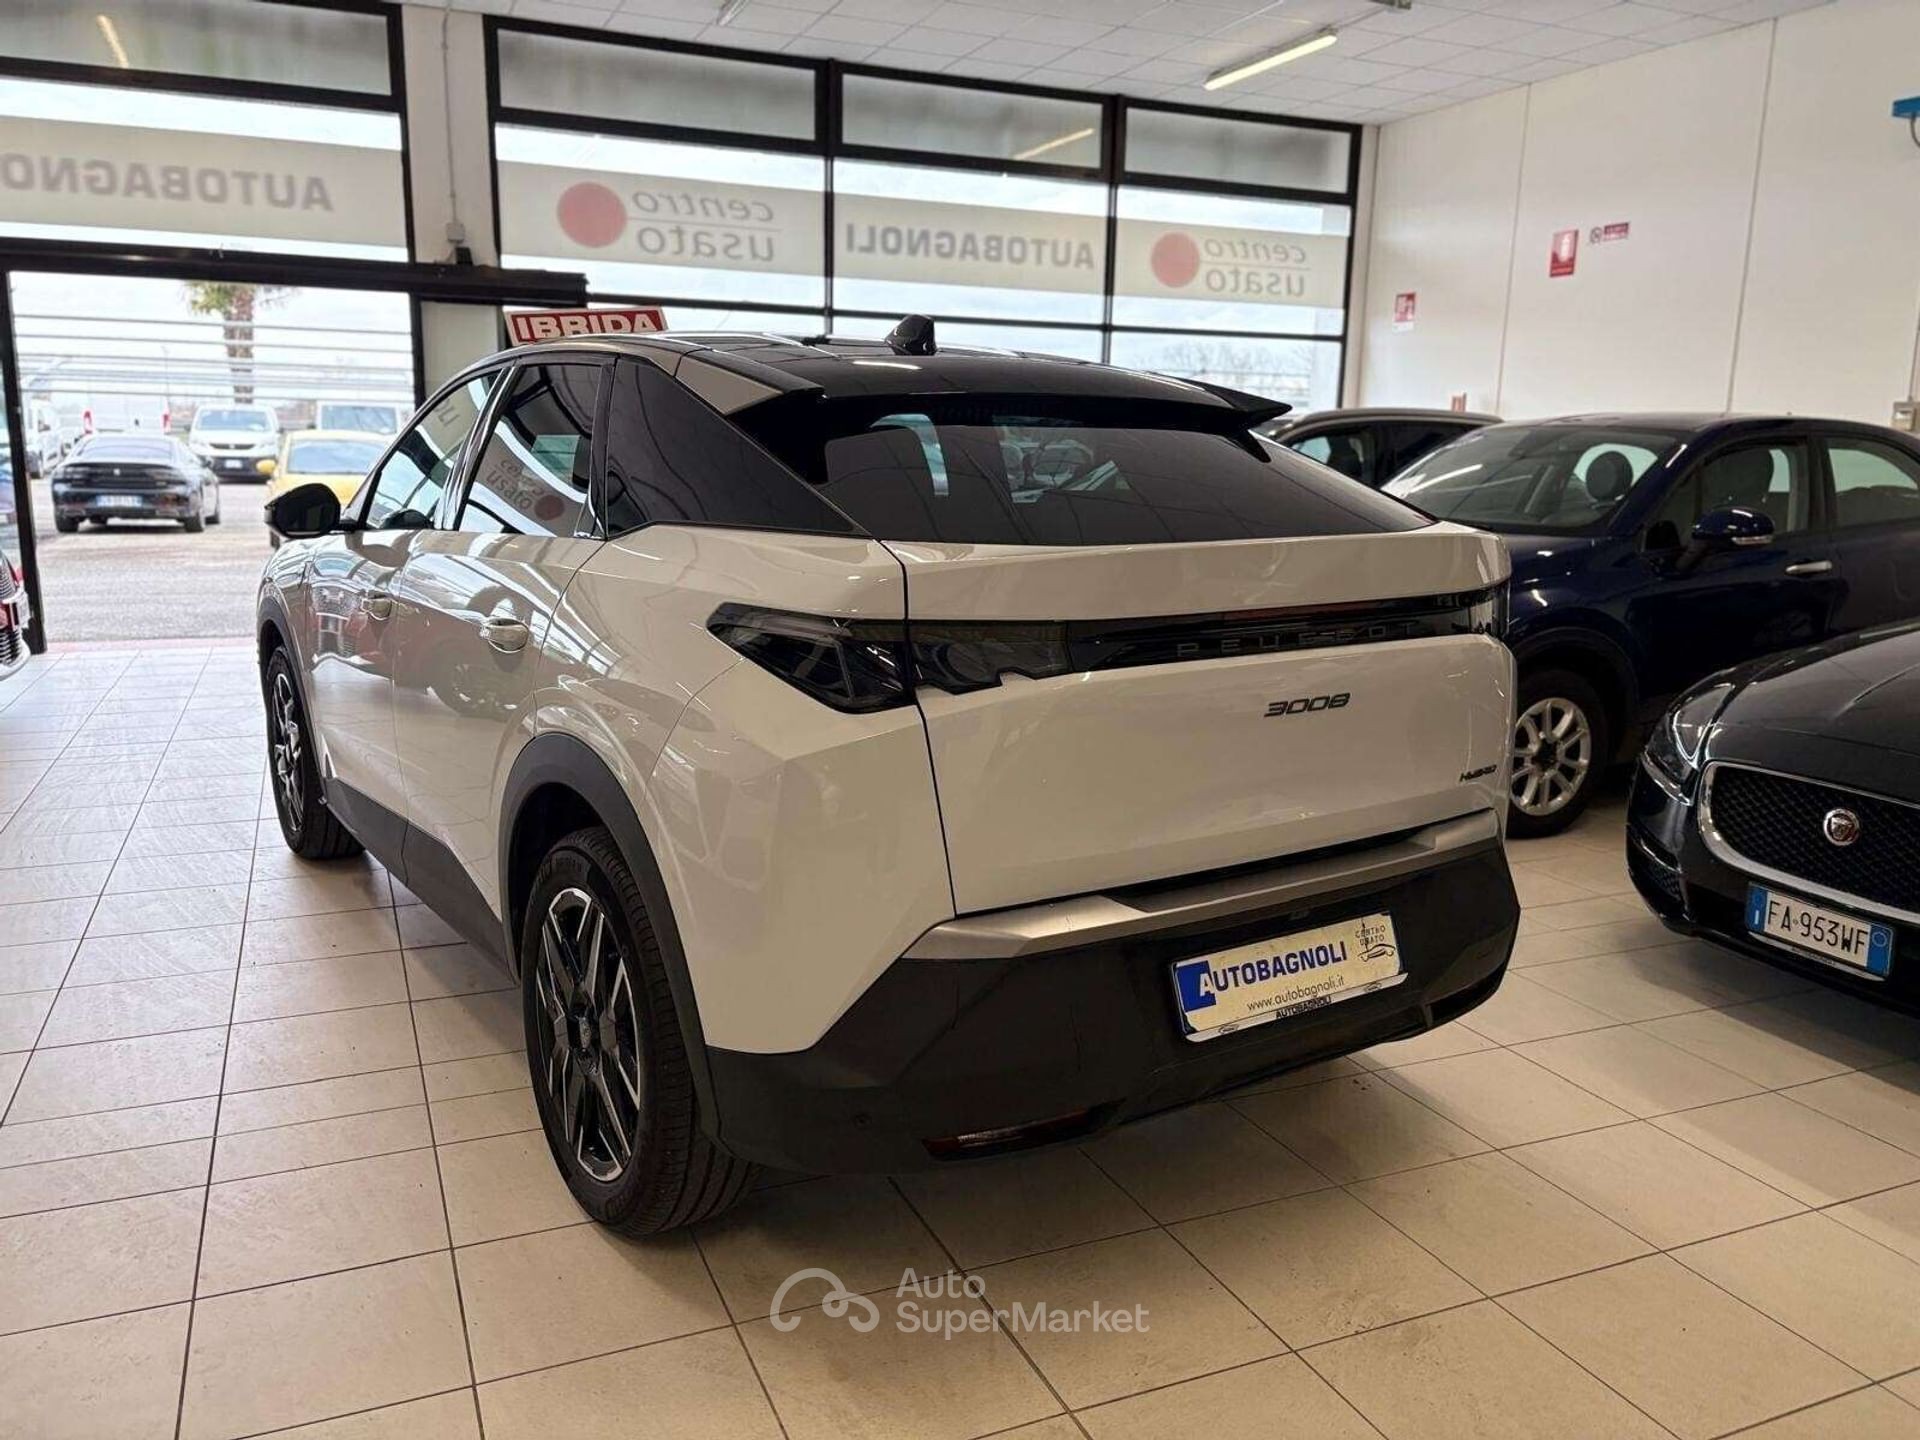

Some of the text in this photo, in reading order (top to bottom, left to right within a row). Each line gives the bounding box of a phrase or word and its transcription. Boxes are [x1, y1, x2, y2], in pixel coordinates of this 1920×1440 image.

[516, 313, 658, 340] IBRIDA
[1264, 692, 1351, 718] 3008
[1199, 940, 1348, 998] AUTOBAGNOLI
[1246, 973, 1345, 1012] www.autobagnoli.it
